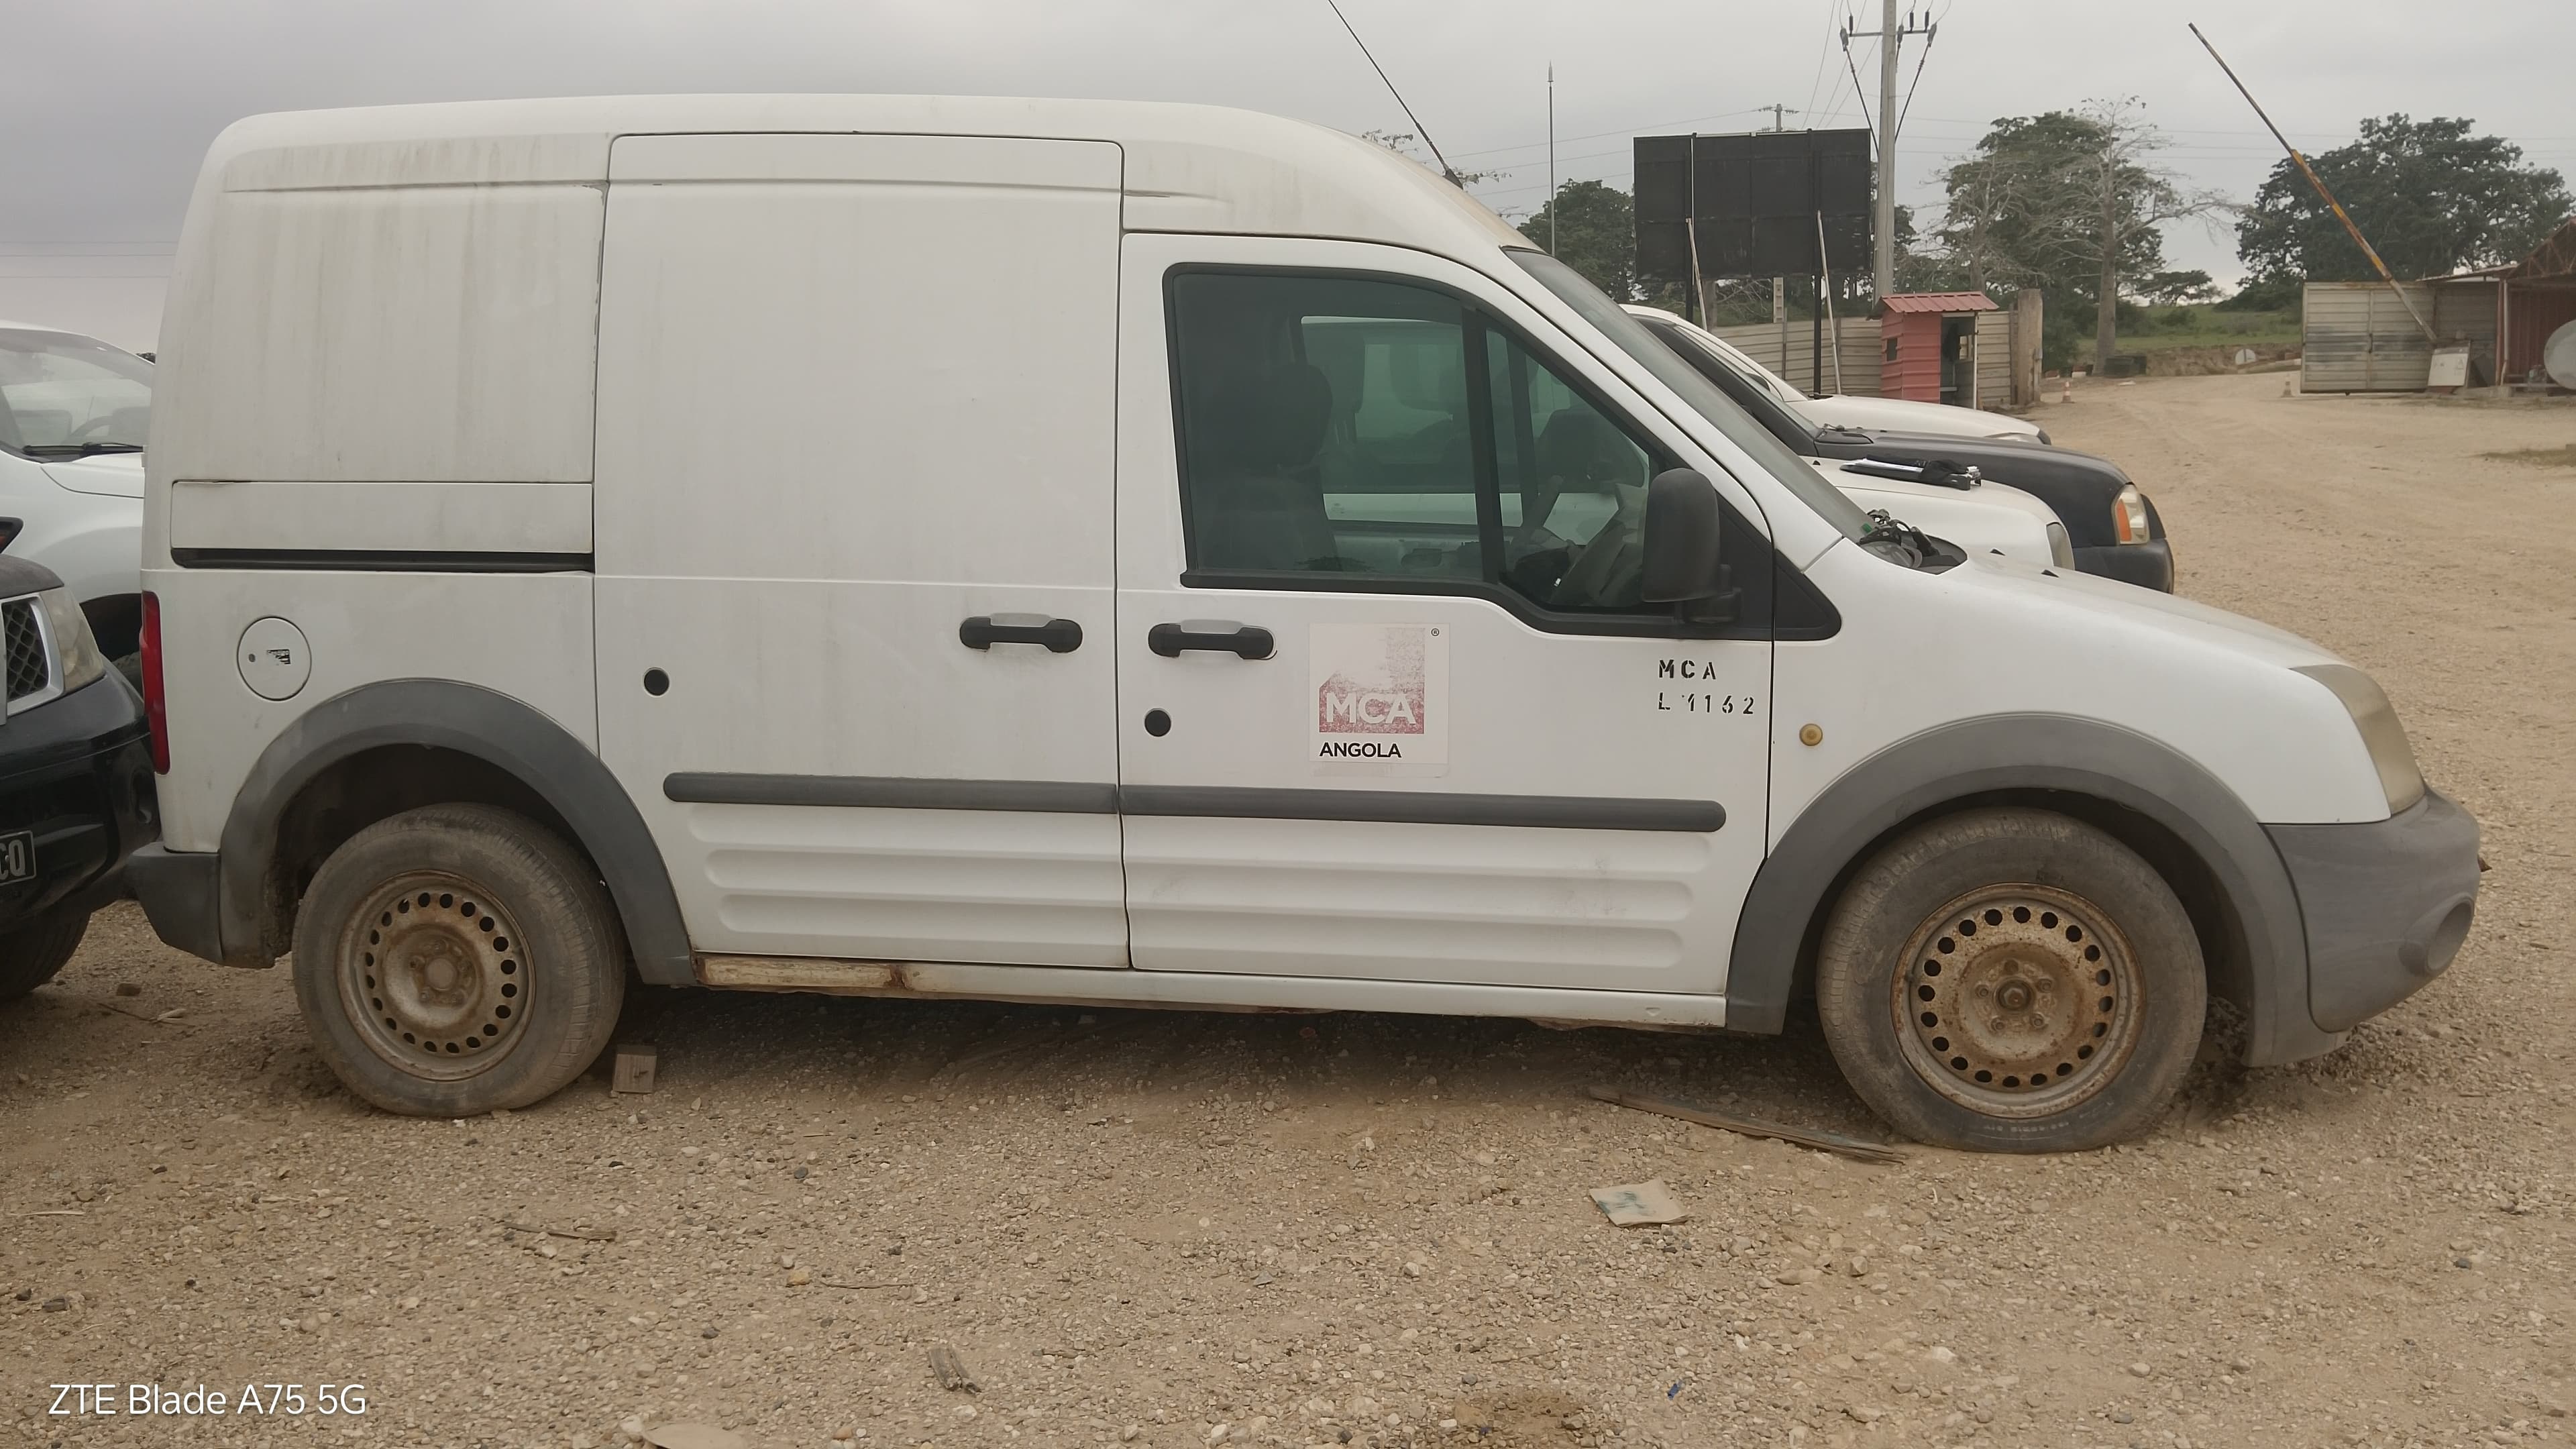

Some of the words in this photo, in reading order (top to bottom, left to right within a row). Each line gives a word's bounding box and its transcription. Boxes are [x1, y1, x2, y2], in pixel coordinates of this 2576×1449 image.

[1658, 659, 1716, 680] MCA
[1326, 691, 1417, 724] MCA
[1319, 741, 1402, 758] ANGOLA
